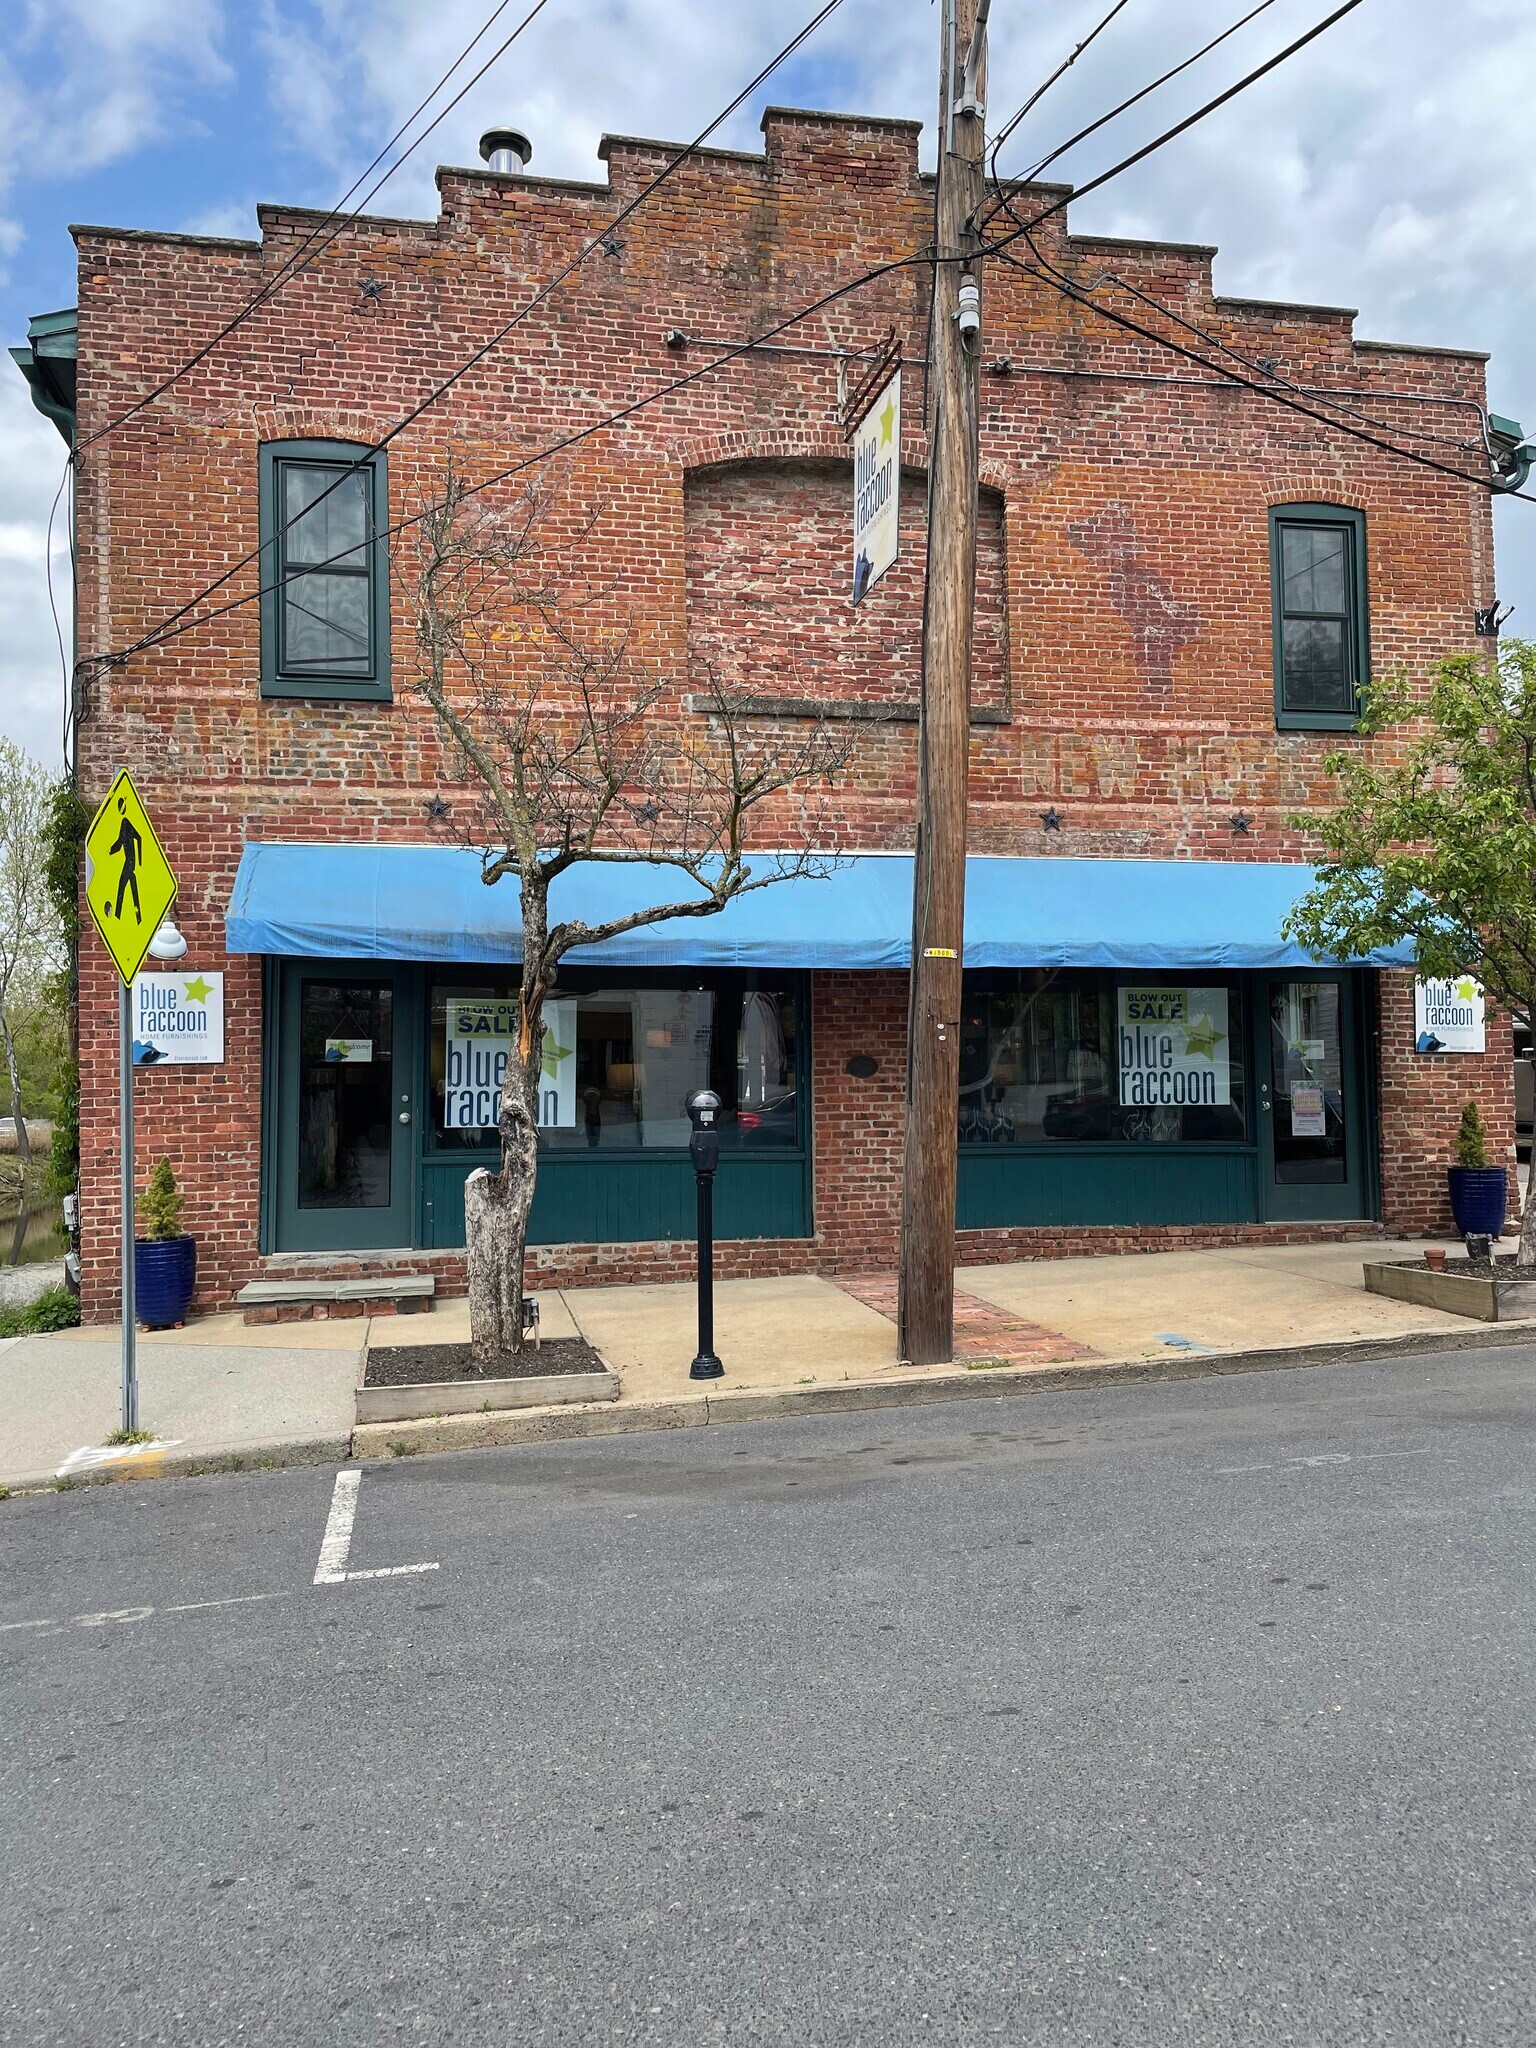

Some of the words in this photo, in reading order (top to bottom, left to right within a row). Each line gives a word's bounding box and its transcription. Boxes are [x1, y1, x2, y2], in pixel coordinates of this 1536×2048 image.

[858, 436, 876, 495] blue
[857, 457, 892, 536] raccoon
[140, 982, 177, 1010] blue
[1128, 993, 1158, 1002] BLOW
[1160, 993, 1182, 1002] OUT
[1425, 983, 1452, 1007] blue
[140, 1010, 207, 1032] raccoon
[458, 1005, 494, 1015] BLOW
[1128, 1003, 1183, 1020] SALE
[1425, 1007, 1473, 1026] raccoon
[162, 1032, 208, 1040] FURNISHINGS
[1120, 1025, 1173, 1069] blue
[447, 1040, 509, 1088] blue
[1121, 1070, 1216, 1105] raccoon
